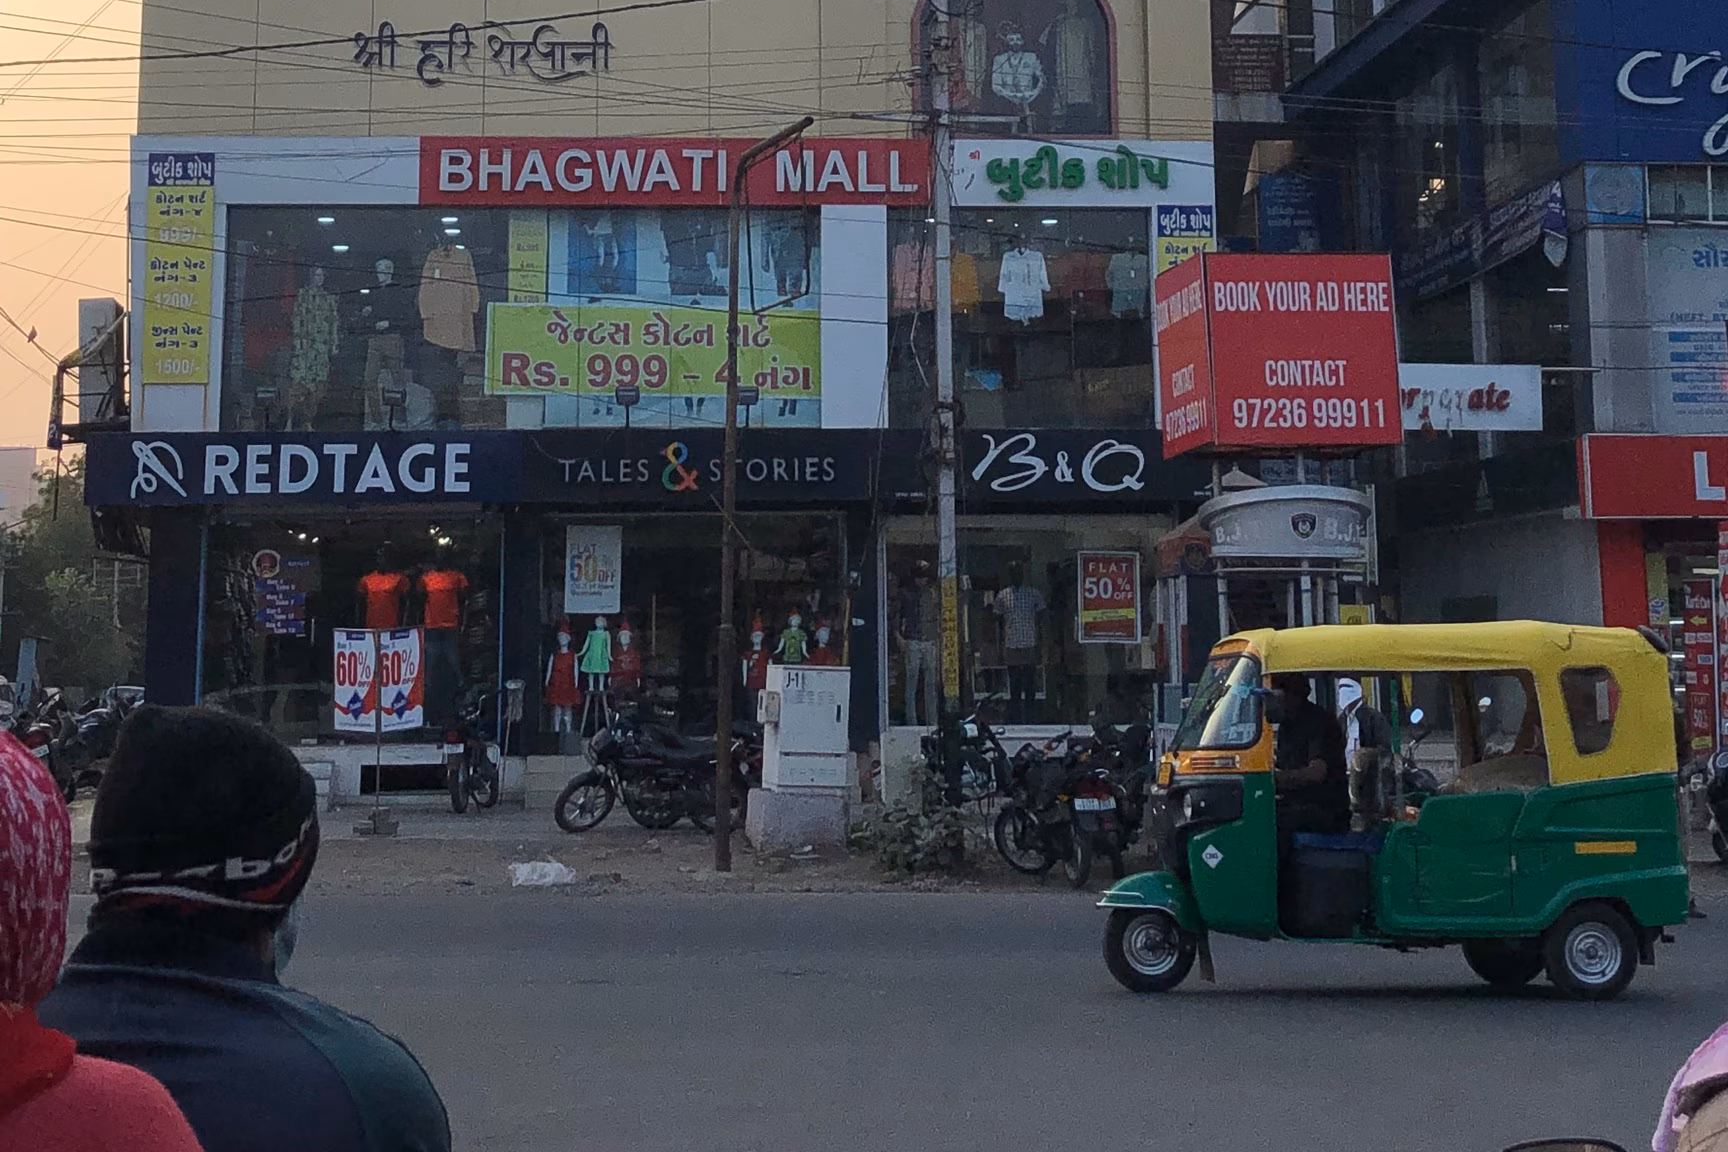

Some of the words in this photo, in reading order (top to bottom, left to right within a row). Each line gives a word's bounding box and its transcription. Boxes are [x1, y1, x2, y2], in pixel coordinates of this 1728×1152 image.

[353, 21, 399, 68] श्री
[415, 22, 478, 85] हरि
[438, 149, 728, 193] BHAGWATI
[775, 150, 920, 193] MALL
[986, 145, 1086, 203] બુટીક
[1097, 144, 1169, 190] શોપ
[1213, 281, 1261, 313] BOOK
[1264, 281, 1312, 312] YOUR
[1316, 281, 1340, 312] AD
[1343, 281, 1390, 312] HERE
[641, 311, 716, 348] કોટન
[501, 352, 570, 387] Rs.
[585, 352, 669, 390] 999
[1265, 359, 1347, 387] CONTACT
[1233, 397, 1308, 429] 97236
[1313, 397, 1386, 429] 99911
[203, 442, 472, 495] REDTAGE
[557, 459, 650, 483] TALES
[660, 441, 699, 491] &
[1087, 561, 1129, 574] FLAT
[1112, 591, 1134, 600] OFF
[336, 650, 372, 687] 60%
